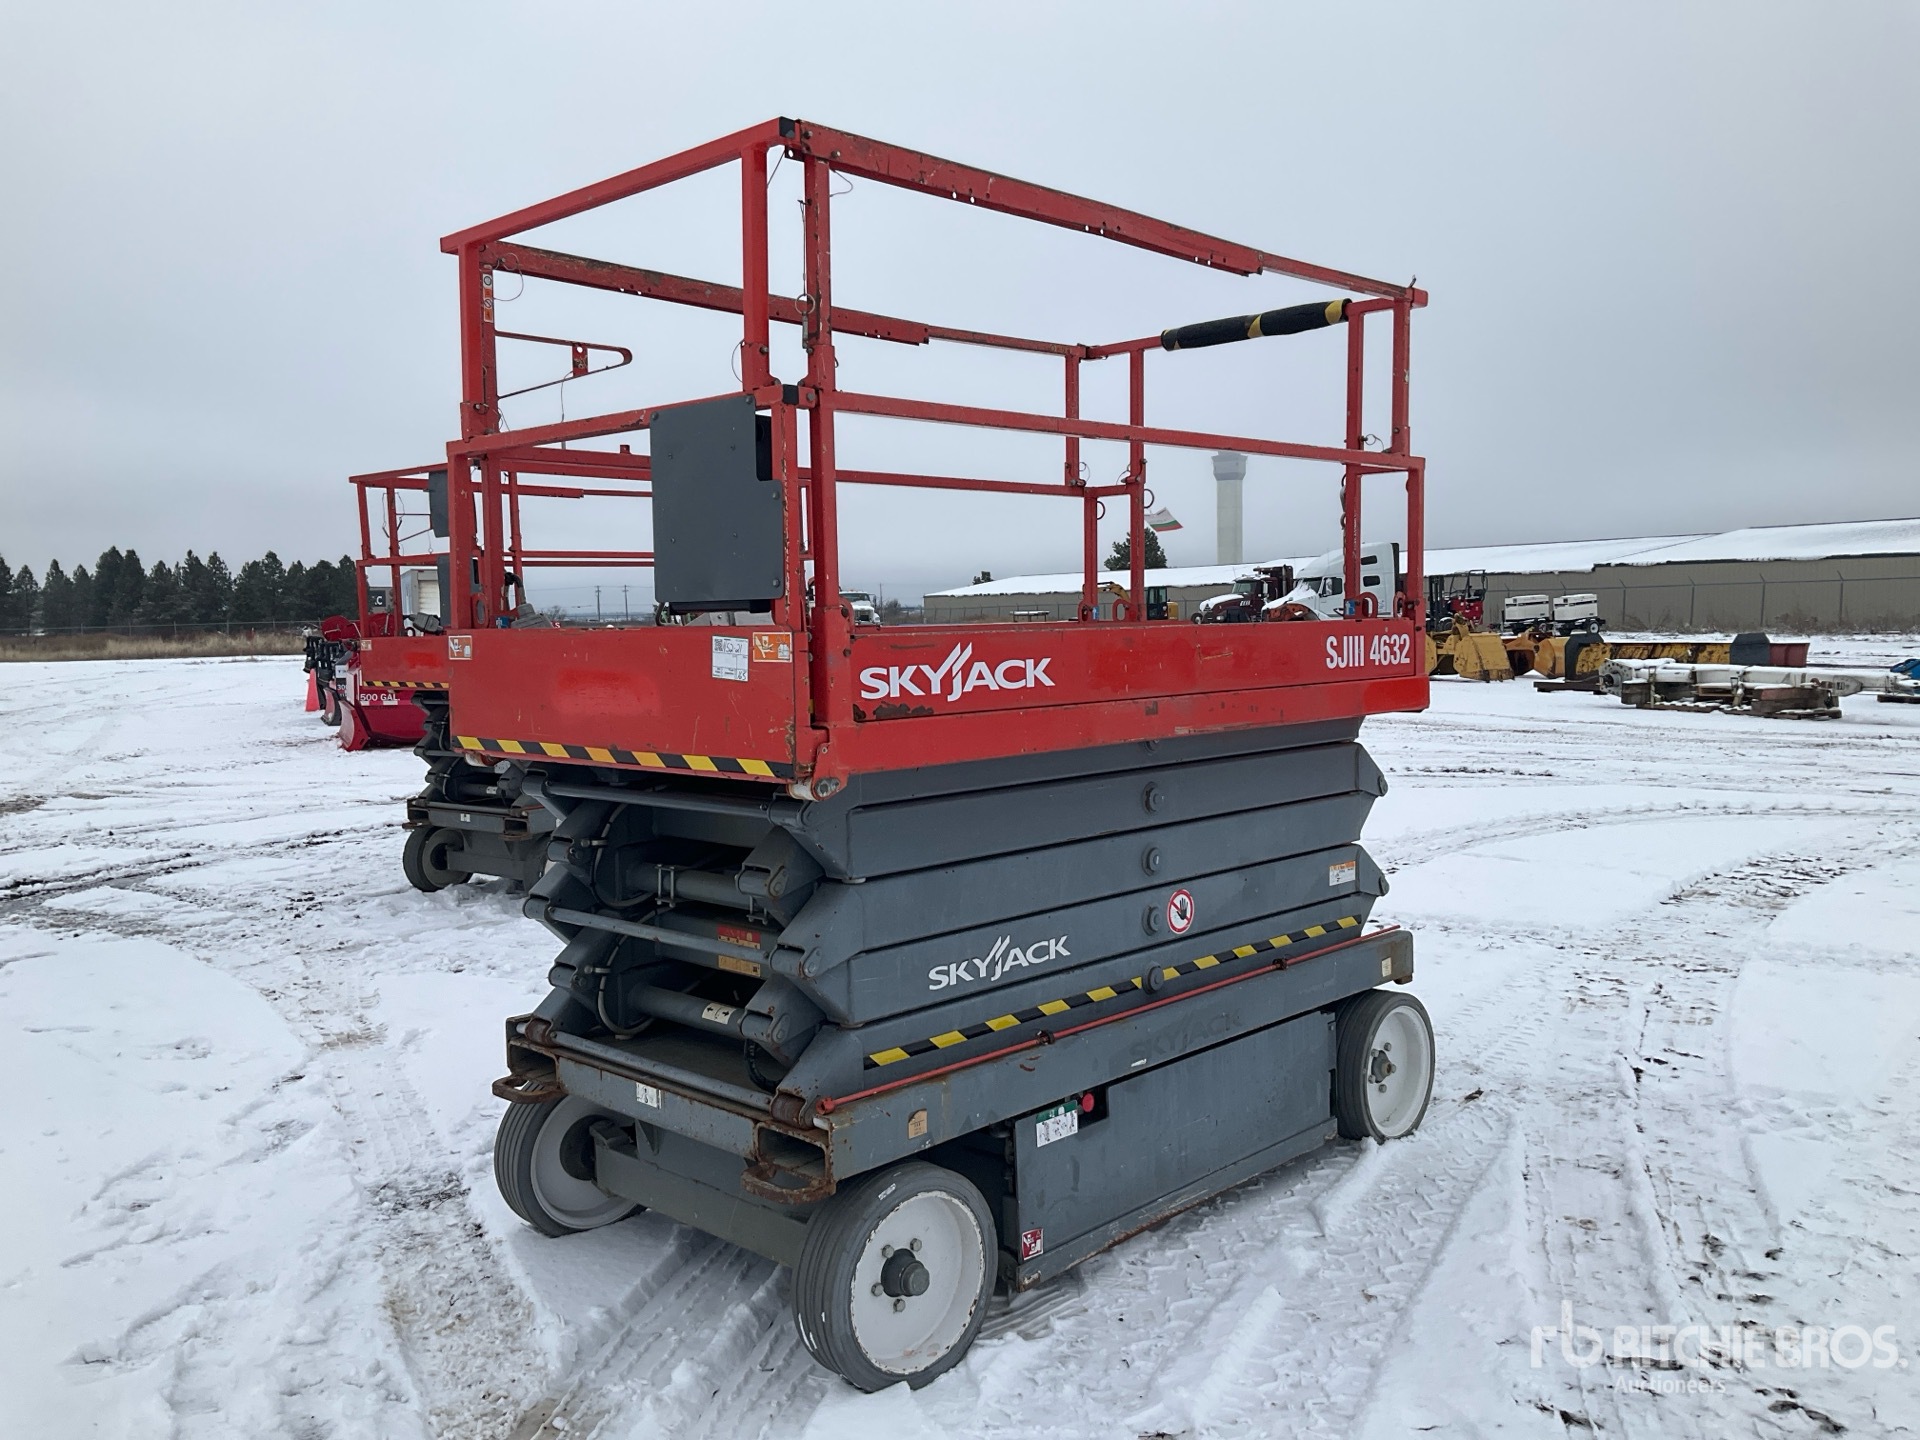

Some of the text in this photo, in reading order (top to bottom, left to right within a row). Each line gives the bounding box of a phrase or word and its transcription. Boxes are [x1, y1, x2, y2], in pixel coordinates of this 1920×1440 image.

[859, 642, 1056, 702] SKYJACK
[1369, 633, 1411, 666] 4632
[928, 935, 1071, 991] SKYJACK
